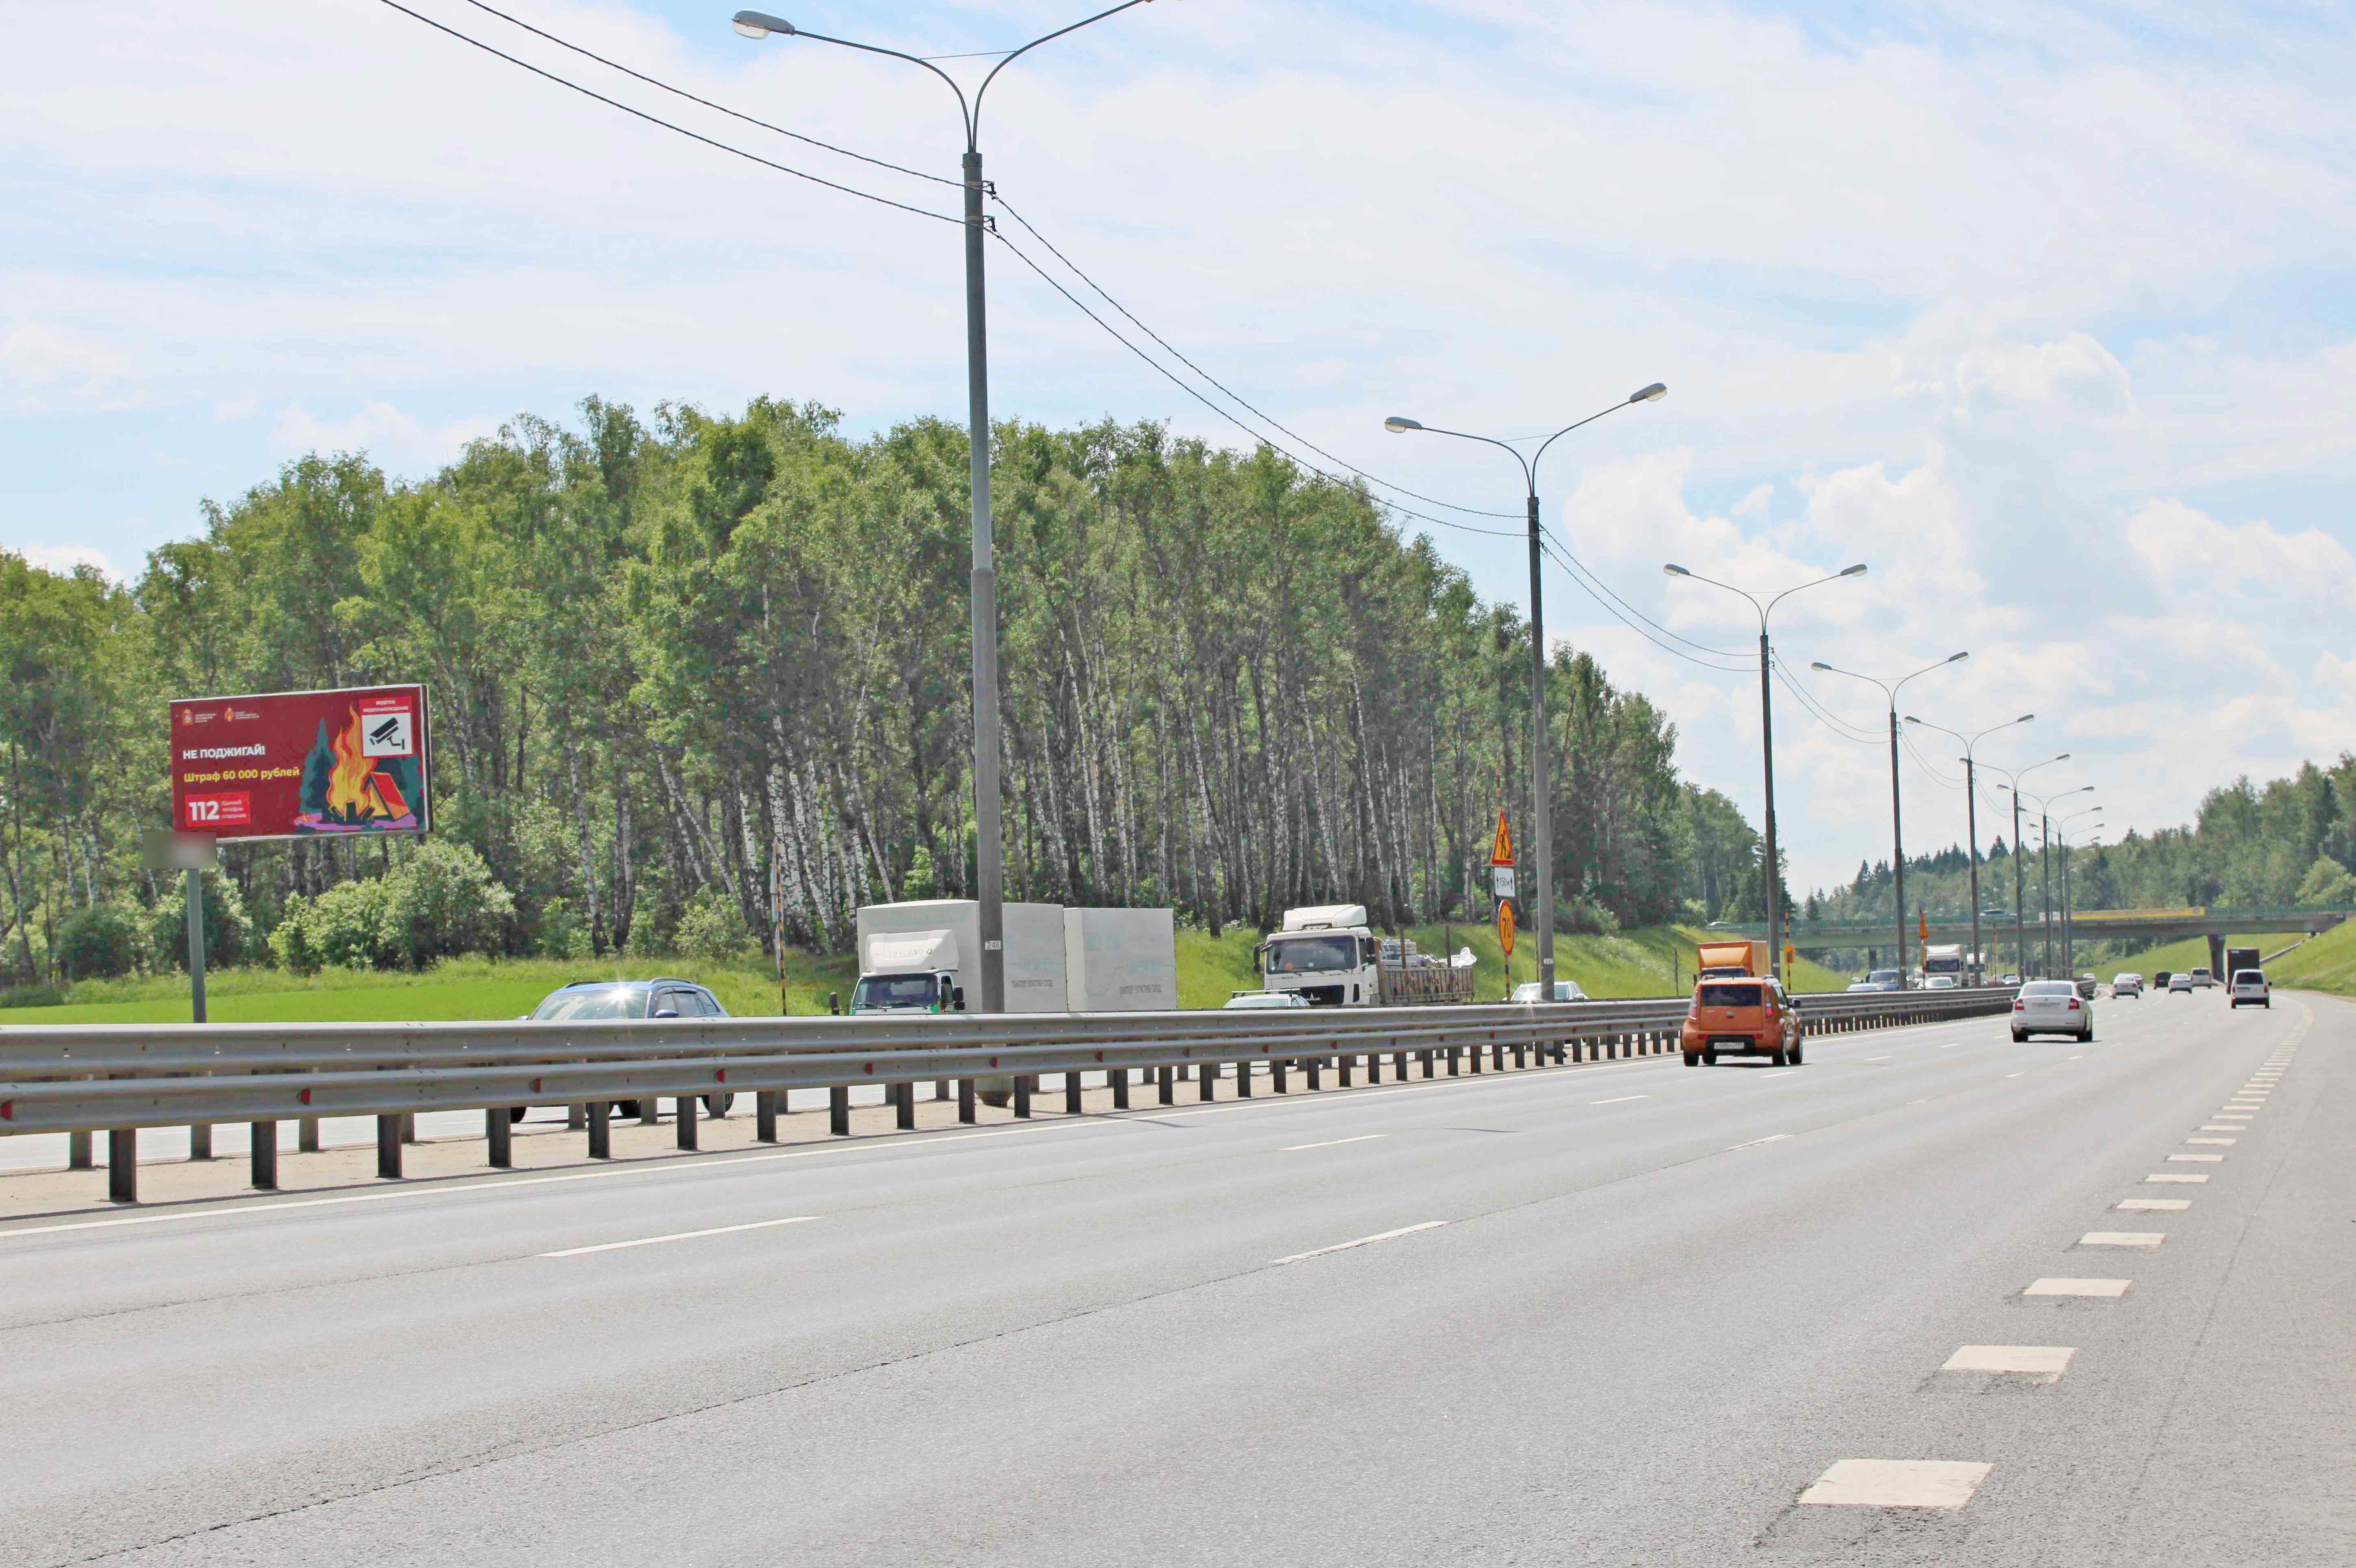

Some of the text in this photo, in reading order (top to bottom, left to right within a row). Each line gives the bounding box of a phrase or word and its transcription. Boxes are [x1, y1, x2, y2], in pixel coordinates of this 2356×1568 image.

[183, 743, 265, 760] НЕ ПОДЖИГАЙ!
[184, 767, 300, 783] Штраф 60 000 рублей
[189, 801, 220, 820] 112
[1502, 917, 1511, 938] 70
[987, 941, 1000, 949] 246
